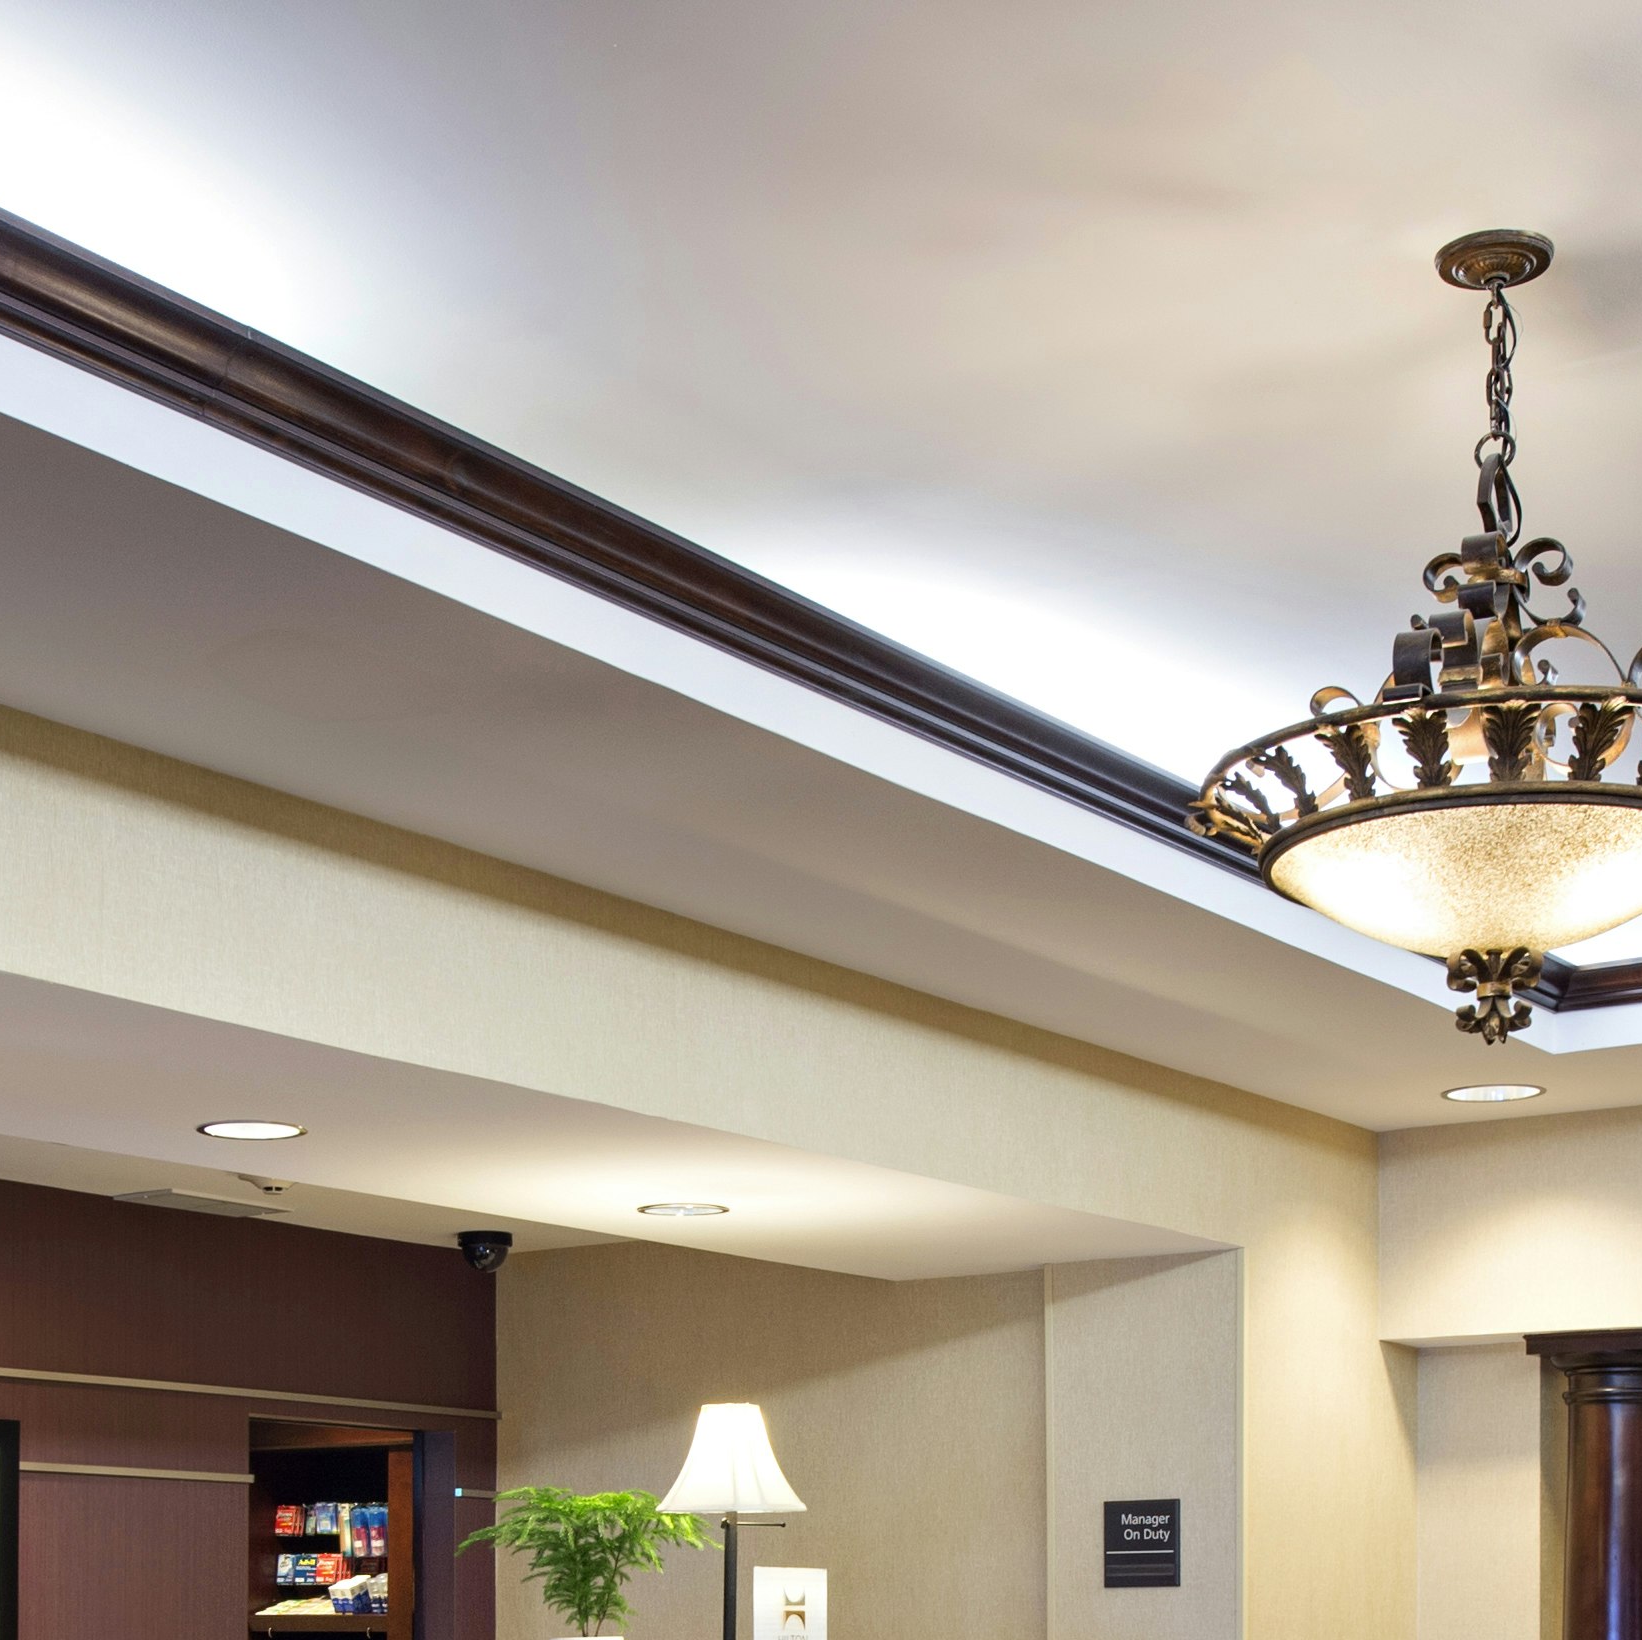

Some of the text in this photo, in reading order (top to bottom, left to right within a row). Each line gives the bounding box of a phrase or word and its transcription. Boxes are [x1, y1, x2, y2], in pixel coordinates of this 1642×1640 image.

[1121, 1513, 1170, 1527] Manager
[1123, 1528, 1170, 1543] On Duty
